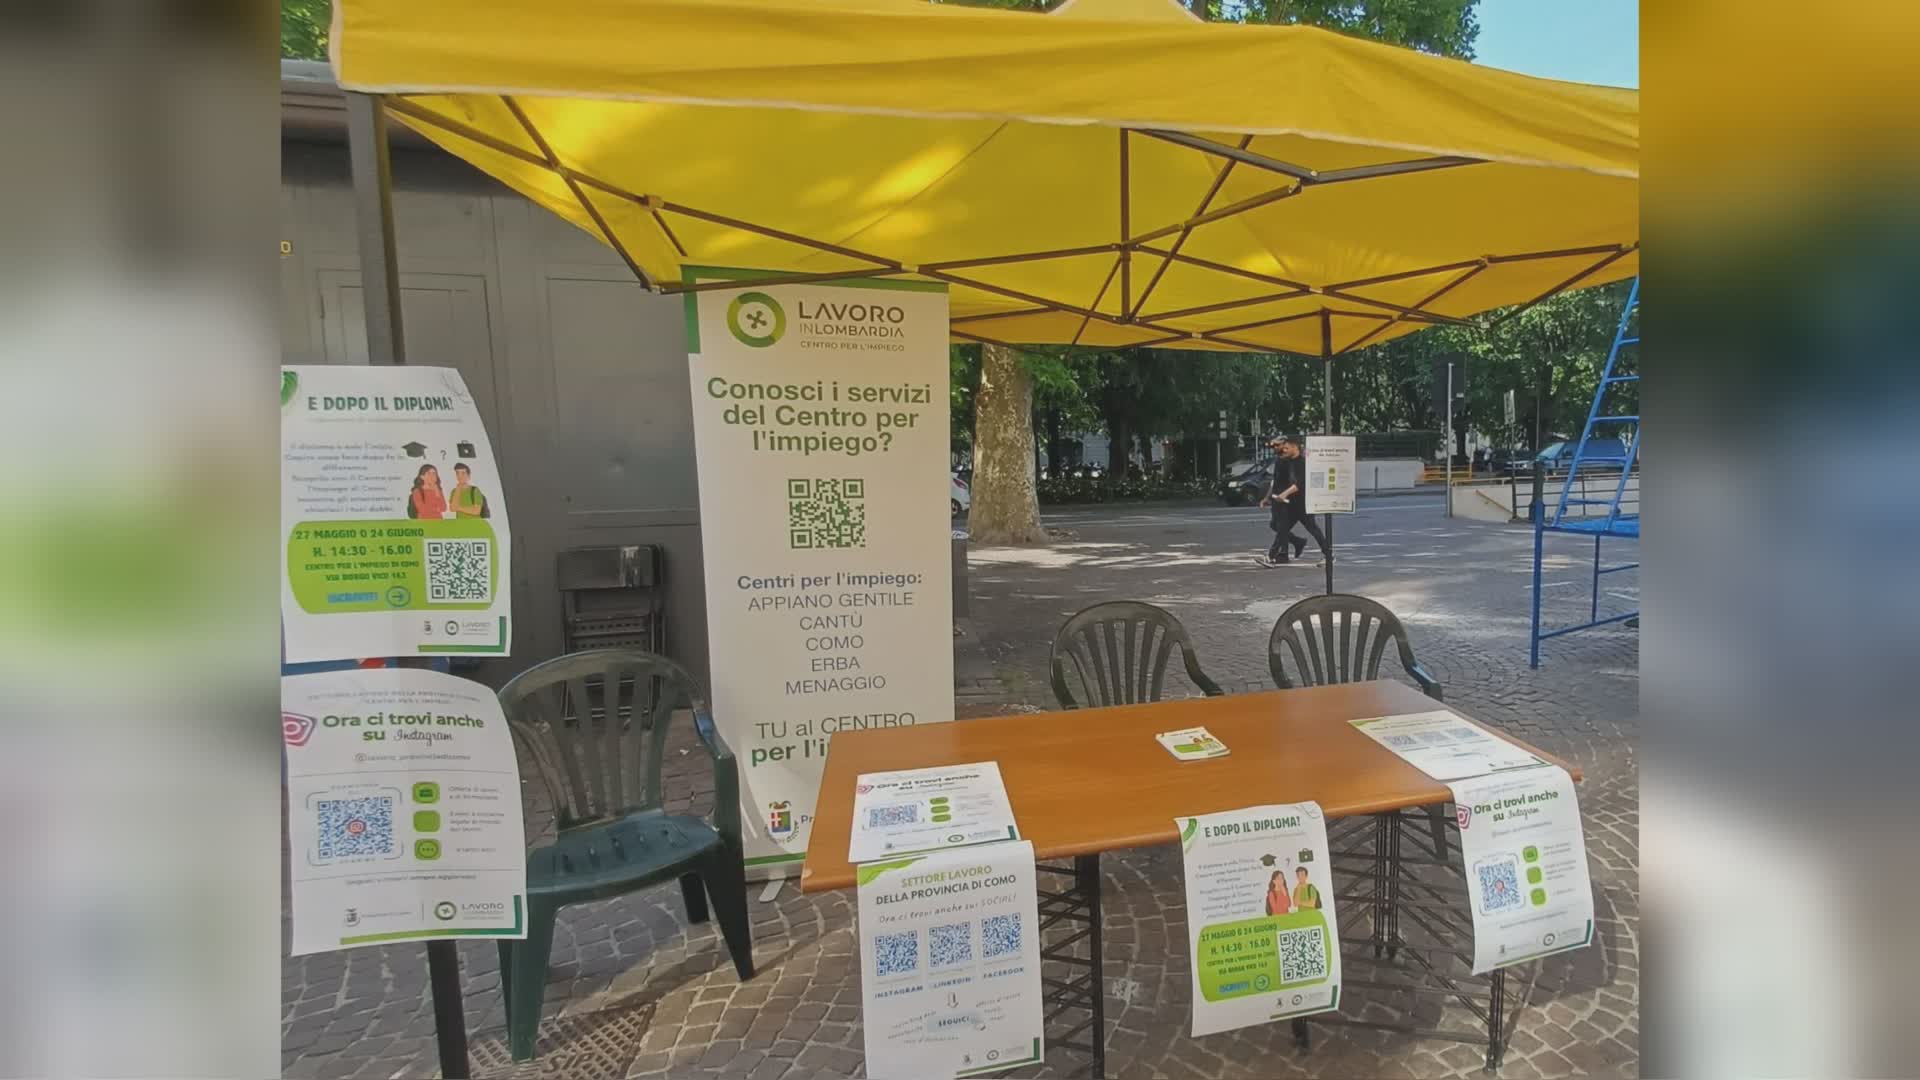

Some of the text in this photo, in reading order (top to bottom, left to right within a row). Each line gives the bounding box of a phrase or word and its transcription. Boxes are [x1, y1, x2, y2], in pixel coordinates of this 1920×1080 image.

[799, 301, 905, 324] LAVORO
[800, 323, 904, 338] INLOMBARDIA
[800, 340, 905, 352] CENTRO PER L'IMPIEGO
[707, 377, 931, 404] Conosci i servizi
[308, 397, 317, 411] E
[323, 397, 369, 411] DOPO
[375, 397, 389, 410] IL
[723, 404, 919, 432] del Centro per
[752, 430, 893, 456] l'impiego?
[295, 530, 310, 540] 27
[314, 529, 357, 539] MAGGIO
[370, 528, 384, 538] 24
[387, 527, 424, 537] GIUGNO
[331, 545, 367, 556] 14:30
[380, 544, 412, 555] 16.00
[737, 572, 923, 590] Centri per l'impiego:
[748, 592, 914, 611] APPIANO GENTILE
[799, 611, 863, 630] CANTÙ
[806, 634, 864, 651] COMO
[811, 656, 861, 672] ERBA
[785, 675, 887, 695] MENAGGIO
[323, 712, 485, 728] Ora ci trovi anche
[755, 720, 787, 739] TU
[796, 719, 813, 737] al
[362, 729, 453, 747] su Instagram
[752, 743, 796, 767] per
[1474, 790, 1559, 814] Ora ci trovi anche
[1493, 813, 1504, 822] su
[1204, 827, 1212, 838] E
[1214, 823, 1241, 837] DOPO
[1243, 821, 1252, 833] IL
[901, 865, 993, 888] SETTORE LAVORO
[876, 874, 1017, 905] DELLA PROVINCIA DI COMO
[462, 902, 505, 911] LAVORO
[935, 903, 963, 915] anche
[1211, 928, 1236, 940] MAGGIO
[1254, 923, 1278, 933] GIUGNO
[1221, 942, 1243, 954] 14:30
[1249, 938, 1271, 949] 16.00
[983, 966, 1025, 980] FACEBOOK
[934, 976, 972, 989] LINKEDIN
[874, 985, 924, 999] INSTAGRAM
